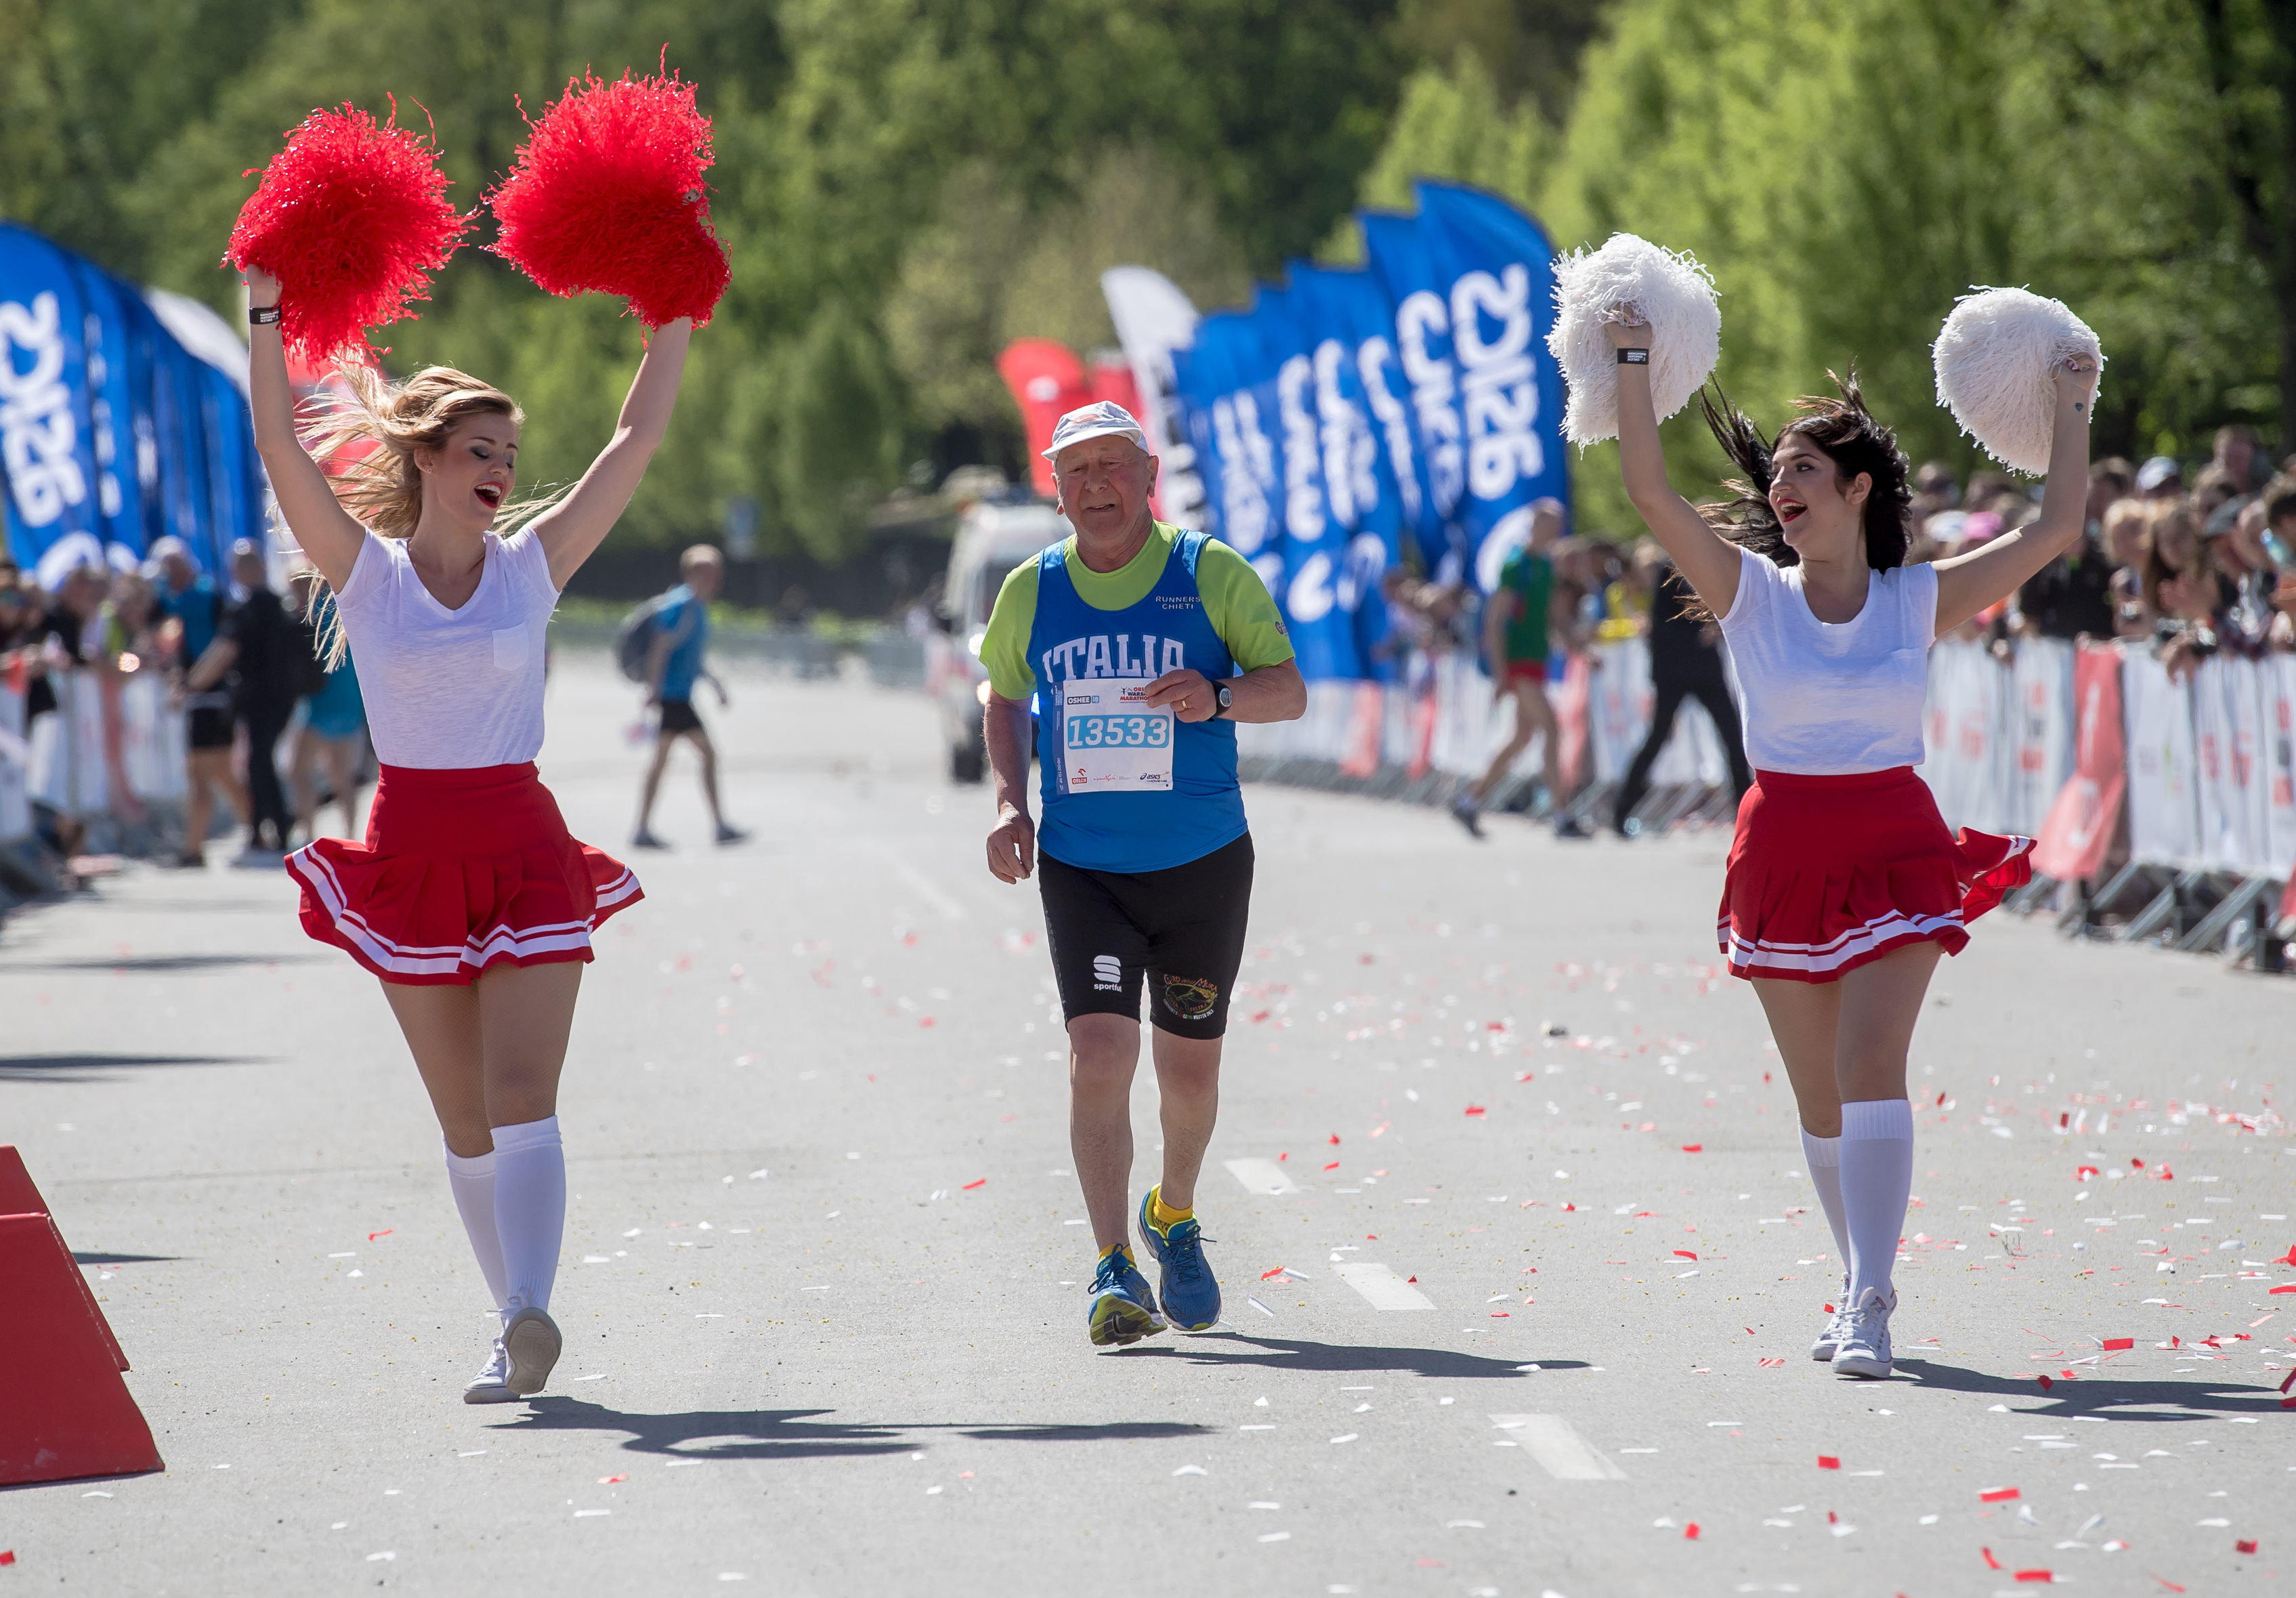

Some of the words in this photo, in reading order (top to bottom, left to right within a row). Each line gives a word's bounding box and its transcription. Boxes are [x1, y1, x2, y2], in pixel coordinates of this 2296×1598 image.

[1042, 634, 1185, 683] ITALIA
[1068, 717, 1167, 747] 13533
[1094, 984, 1122, 993] sportful
[1164, 974, 1182, 985] GIRO
[1193, 977, 1217, 992] MURA
